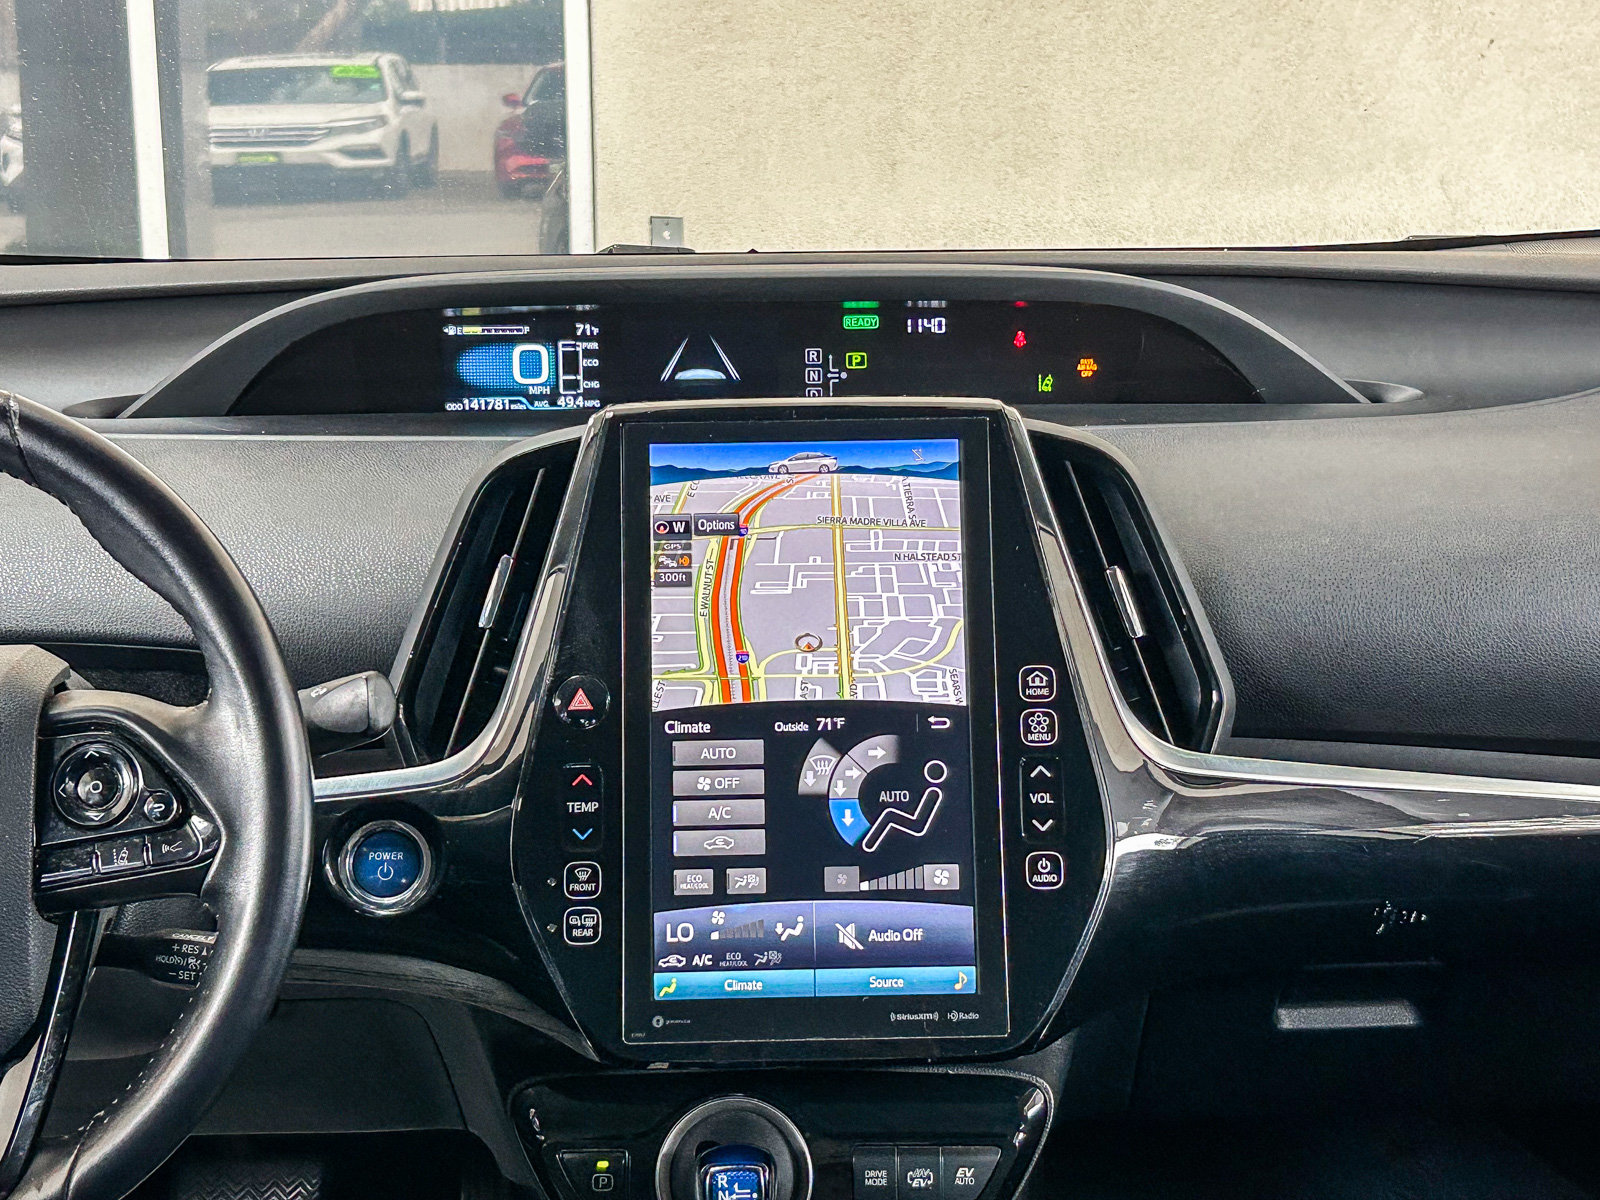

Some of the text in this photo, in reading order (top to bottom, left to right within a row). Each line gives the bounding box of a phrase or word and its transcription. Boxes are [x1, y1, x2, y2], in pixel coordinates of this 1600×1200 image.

[845, 317, 877, 327] READY
[582, 359, 599, 367] ECO
[583, 381, 600, 389] CHG
[528, 386, 550, 395] MPH
[446, 403, 463, 411] ODO
[463, 399, 510, 411] 141781
[557, 396, 584, 408] 49.4
[653, 494, 671, 503] AVE
[903, 483, 915, 513] TIERRA
[698, 519, 735, 532] Options
[817, 515, 926, 528] SIERRA MADRE VILLA AVE
[672, 521, 686, 533] W
[894, 553, 901, 561] N
[903, 553, 950, 561] HALSTEAD
[659, 572, 687, 582] 300ft
[701, 573, 713, 609] WALNUT
[949, 668, 962, 697] SEARS
[1026, 687, 1050, 696] HOME
[664, 717, 846, 734] Climate Outside 71°F
[1027, 733, 1051, 741] MENU
[700, 747, 736, 760] AUTO
[715, 777, 740, 789] OFF
[879, 790, 910, 803] AUTO
[1029, 792, 1054, 804] VOL
[567, 801, 599, 813] TEMP
[708, 806, 732, 819] A/C
[368, 851, 404, 861] POWER
[686, 874, 703, 883] ECO
[1032, 873, 1058, 883] AUDIO
[569, 882, 597, 892] FRONT
[572, 928, 594, 937] REAR
[666, 922, 695, 943] LO
[868, 928, 923, 942] Audio Off
[692, 954, 713, 967] A/C
[726, 952, 742, 961] ECO
[724, 976, 904, 991] Climate Source
[959, 1012, 980, 1020] Radio
[865, 1170, 888, 1178] DRIVE
[956, 1168, 975, 1177] EV
[718, 1174, 728, 1188] R
[865, 1178, 888, 1186] MODE
[912, 1178, 929, 1188] EV
[954, 1178, 975, 1186] AUTO
[718, 1190, 729, 1200] N
